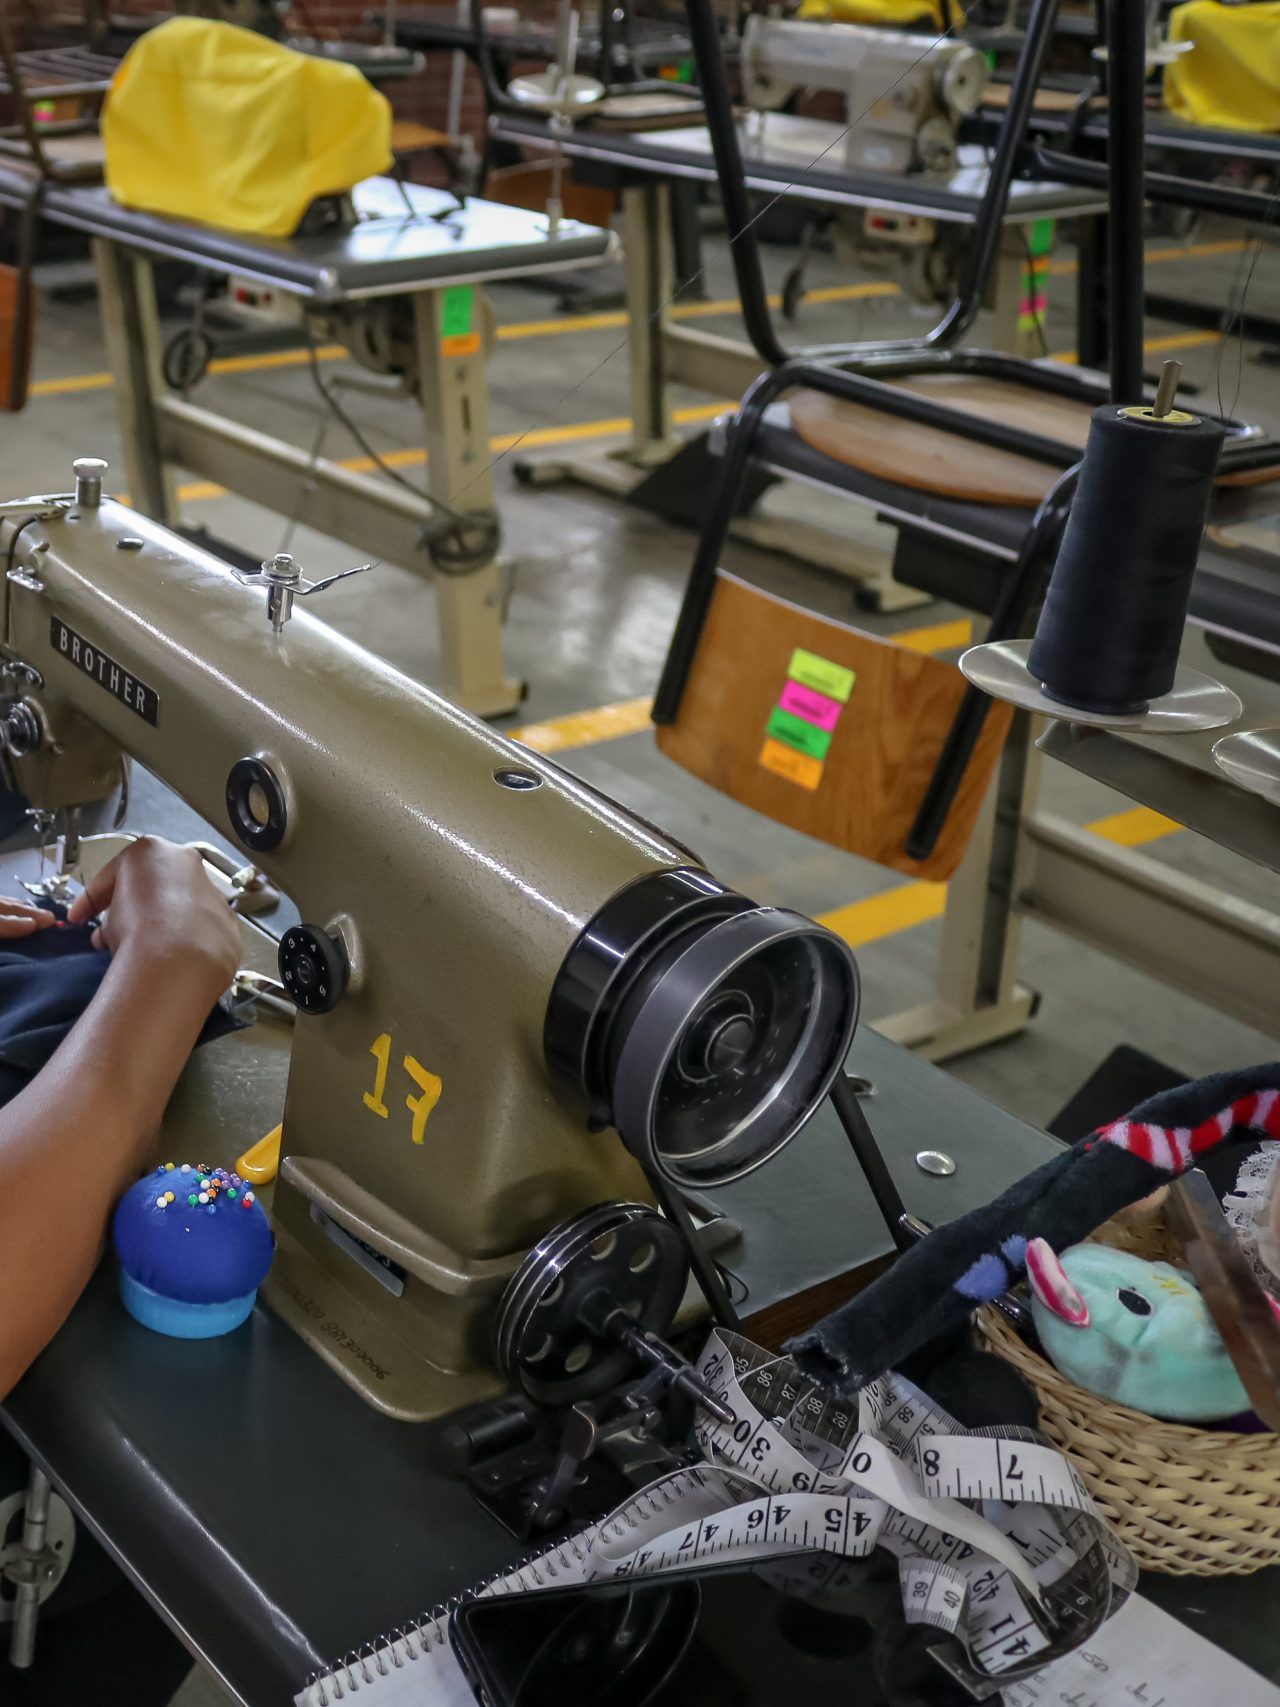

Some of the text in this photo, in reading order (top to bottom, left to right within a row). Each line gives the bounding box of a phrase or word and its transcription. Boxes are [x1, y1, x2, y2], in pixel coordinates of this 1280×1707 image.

[60, 626, 146, 713] BROTHER
[288, 938, 296, 949] 3
[363, 1033, 443, 1145] 17
[735, 1356, 749, 1373] 85
[757, 1369, 773, 1387] 86
[781, 1383, 797, 1401] 87
[807, 1397, 823, 1415] 88
[898, 1406, 914, 1424] 58
[832, 1412, 849, 1429] 89
[733, 1419, 771, 1462] 30
[852, 1452, 872, 1474] 0
[922, 1449, 940, 1477] 8
[1005, 1454, 1024, 1480] 7
[747, 1505, 791, 1529] 46
[825, 1508, 872, 1536] 45
[678, 1524, 720, 1550] 47
[912, 1581, 929, 1599] 39
[973, 1570, 1000, 1603] 42
[943, 1590, 961, 1609] 40
[989, 1613, 1031, 1656] 41
